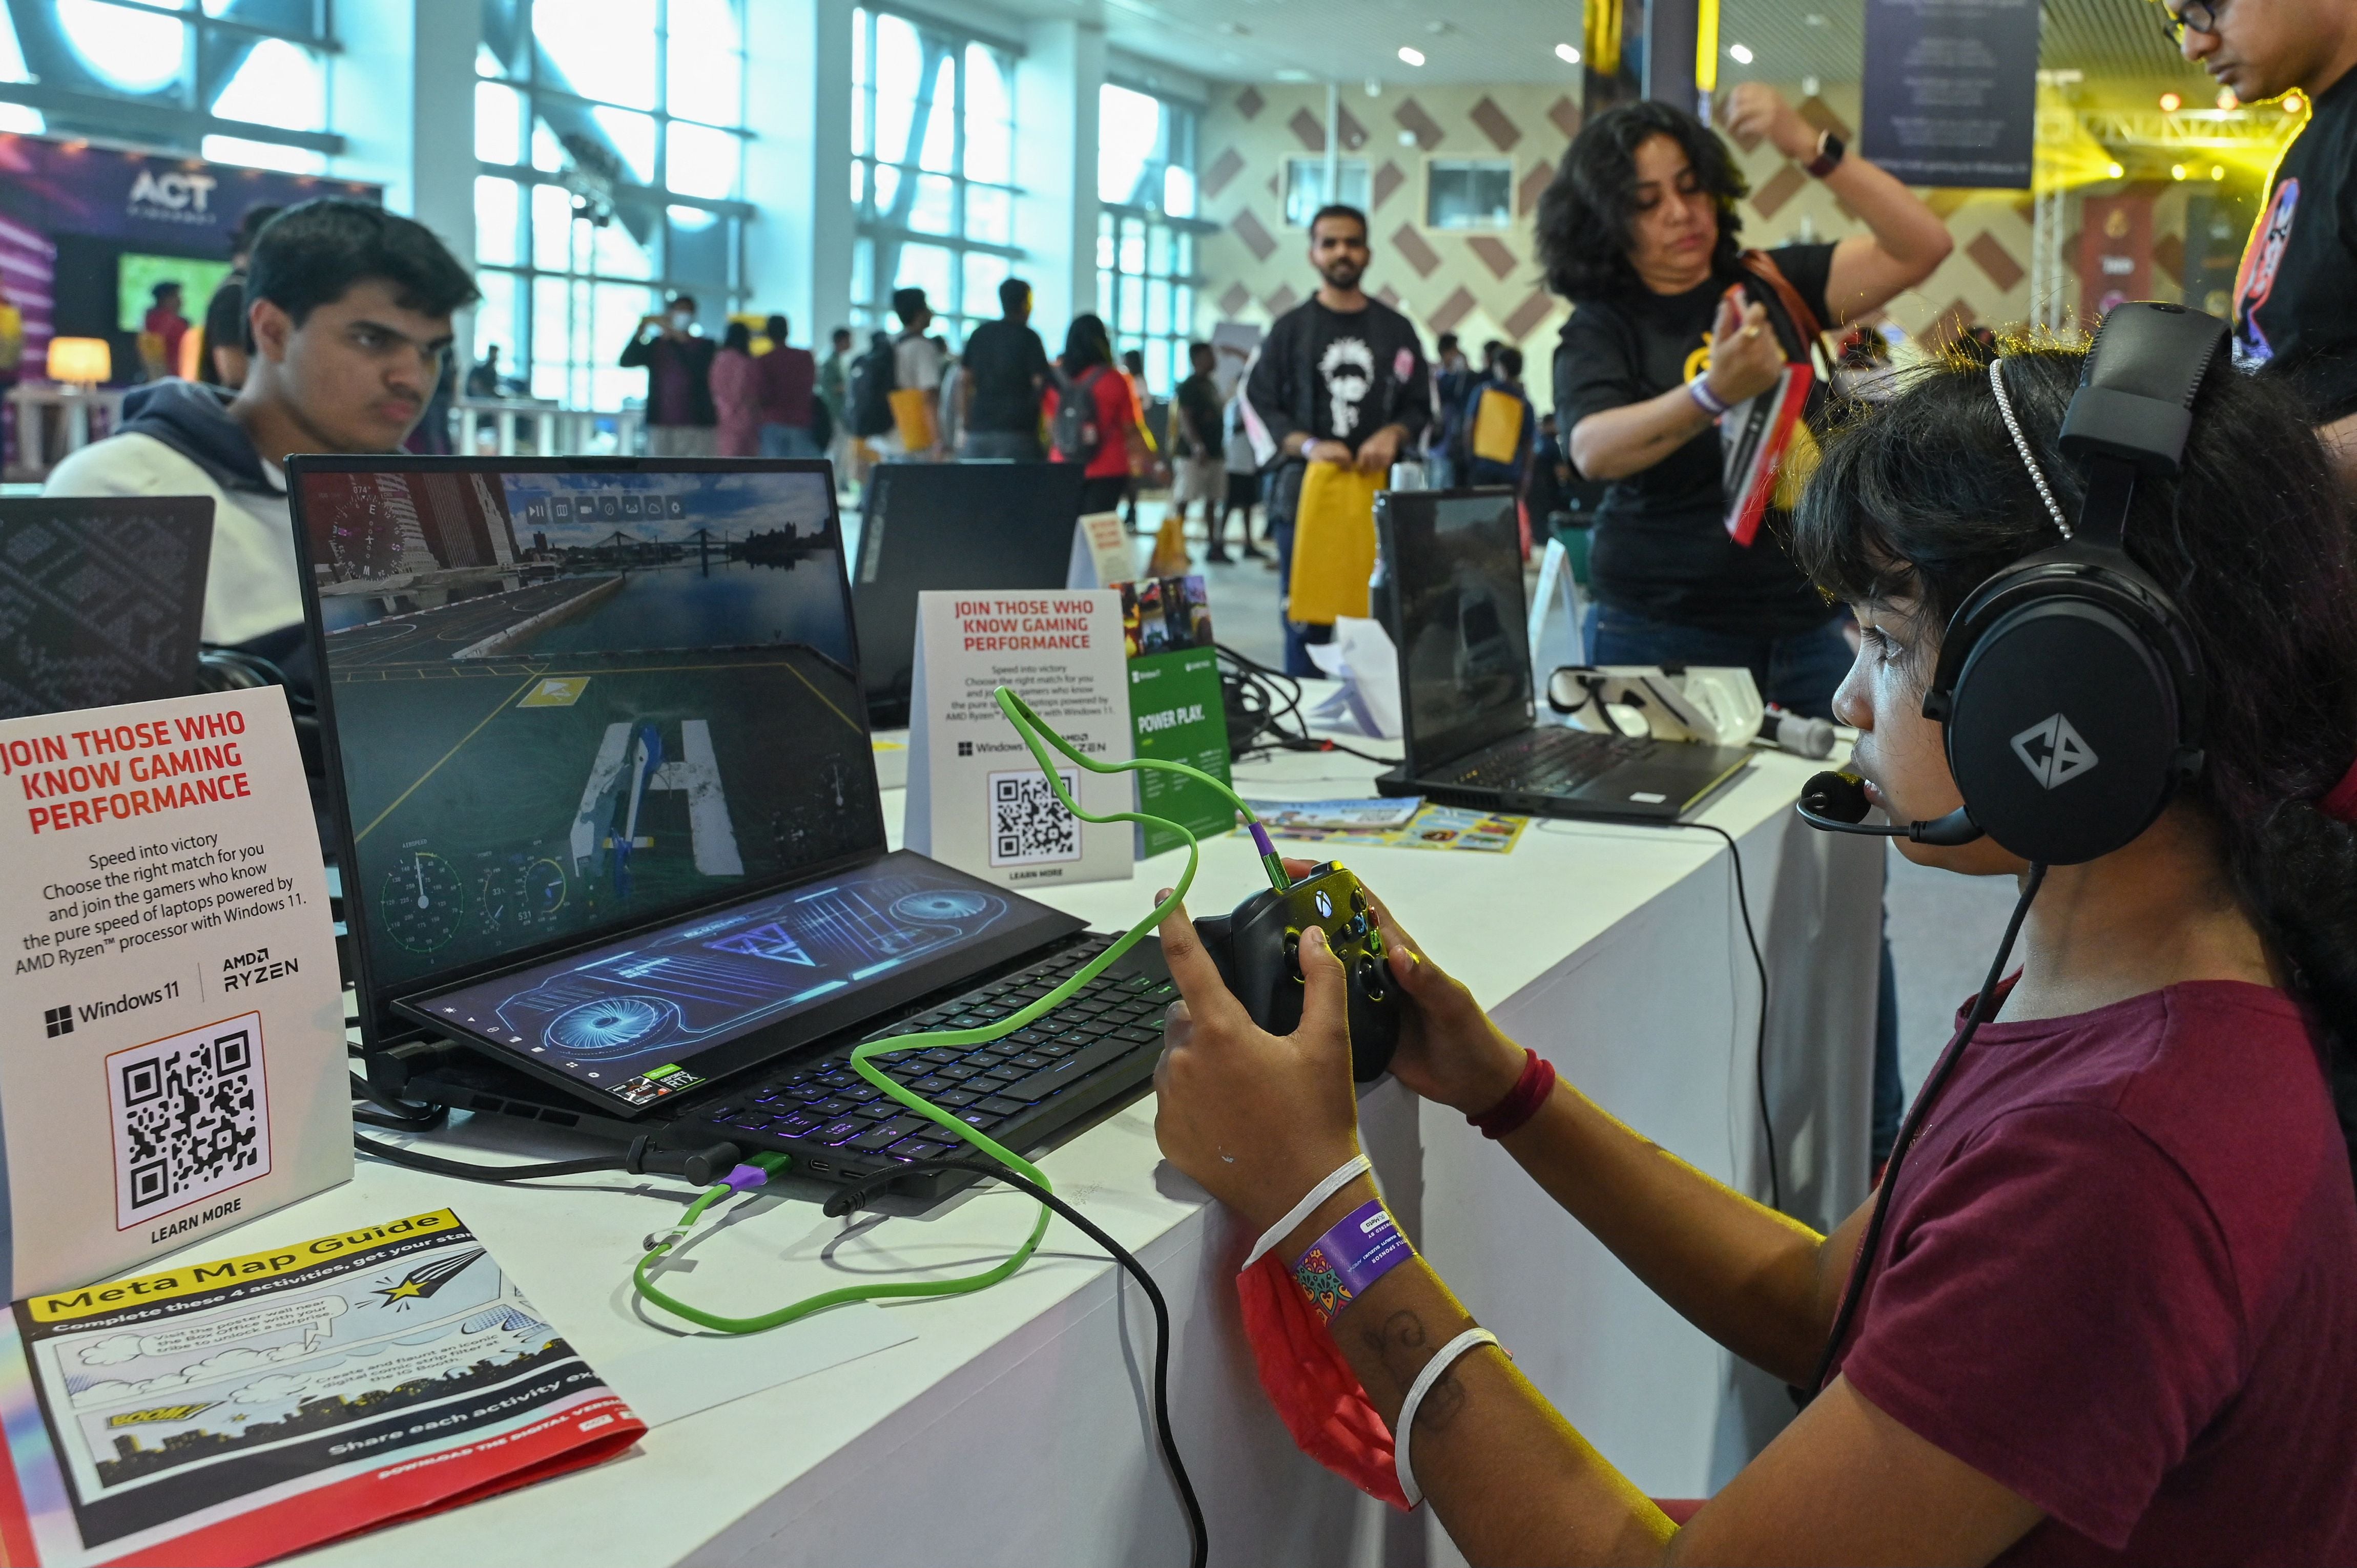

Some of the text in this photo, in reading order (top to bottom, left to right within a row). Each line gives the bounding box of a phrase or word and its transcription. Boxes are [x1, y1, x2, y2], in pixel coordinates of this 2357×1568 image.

[130, 170, 217, 213] ACT
[956, 600, 1093, 617] JOIN THOSE WHO
[964, 618, 1088, 633] KNOW GAMING
[964, 635, 1090, 651] PERFORMANCE
[1138, 703, 1206, 734] POWER PLAY.
[1, 710, 245, 776] JOIN THOSE WHO
[976, 743, 1023, 752] Windows
[22, 742, 242, 800] KNOW GAMING
[28, 772, 251, 834] PERFORMANCE
[89, 833, 217, 870] Speed into victory
[43, 844, 264, 900] Choose the right match for you
[1009, 868, 1063, 881] LEARN MORE
[49, 863, 266, 922] and join the gamers who know
[23, 876, 293, 950] the pure speed of laptops powered by
[518, 910, 532, 921] 531
[15, 892, 306, 975] AMD Ryzen™ processor with Windows 11.
[223, 957, 299, 992] RYZEN
[78, 980, 179, 1022] Windows 11
[625, 1083, 653, 1096] RYZEN
[659, 1070, 688, 1083] GEFORCE
[666, 1073, 698, 1088] RTX
[907, 1143, 927, 1154] CTRL
[151, 1197, 241, 1244] LEARN MORE
[1366, 1217, 1380, 1227] Meta
[1368, 1231, 1375, 1240] BY
[1362, 1245, 1381, 1260] SUZUKI
[1371, 1244, 1396, 1264] SPONSOR
[1381, 1235, 1397, 1246] MARUTI
[48, 1217, 440, 1313] Meta Map Guide
[52, 1308, 162, 1332] Complete
[165, 1295, 225, 1312] these
[250, 1265, 350, 1293] activities,
[353, 1251, 387, 1267] get
[389, 1240, 431, 1256] your
[153, 1331, 185, 1341] Visit
[217, 1314, 261, 1330] poster
[265, 1307, 293, 1316] wall
[296, 1301, 325, 1310] near
[157, 1344, 191, 1353] tribe
[214, 1328, 261, 1343] unlock
[275, 1312, 334, 1327] surprise.
[185, 1333, 212, 1342] Box
[216, 1322, 260, 1335] Office
[263, 1314, 294, 1323] with
[297, 1306, 326, 1318] your
[328, 1431, 404, 1455] Share
[409, 1414, 468, 1434] each
[473, 1381, 560, 1417] activity
